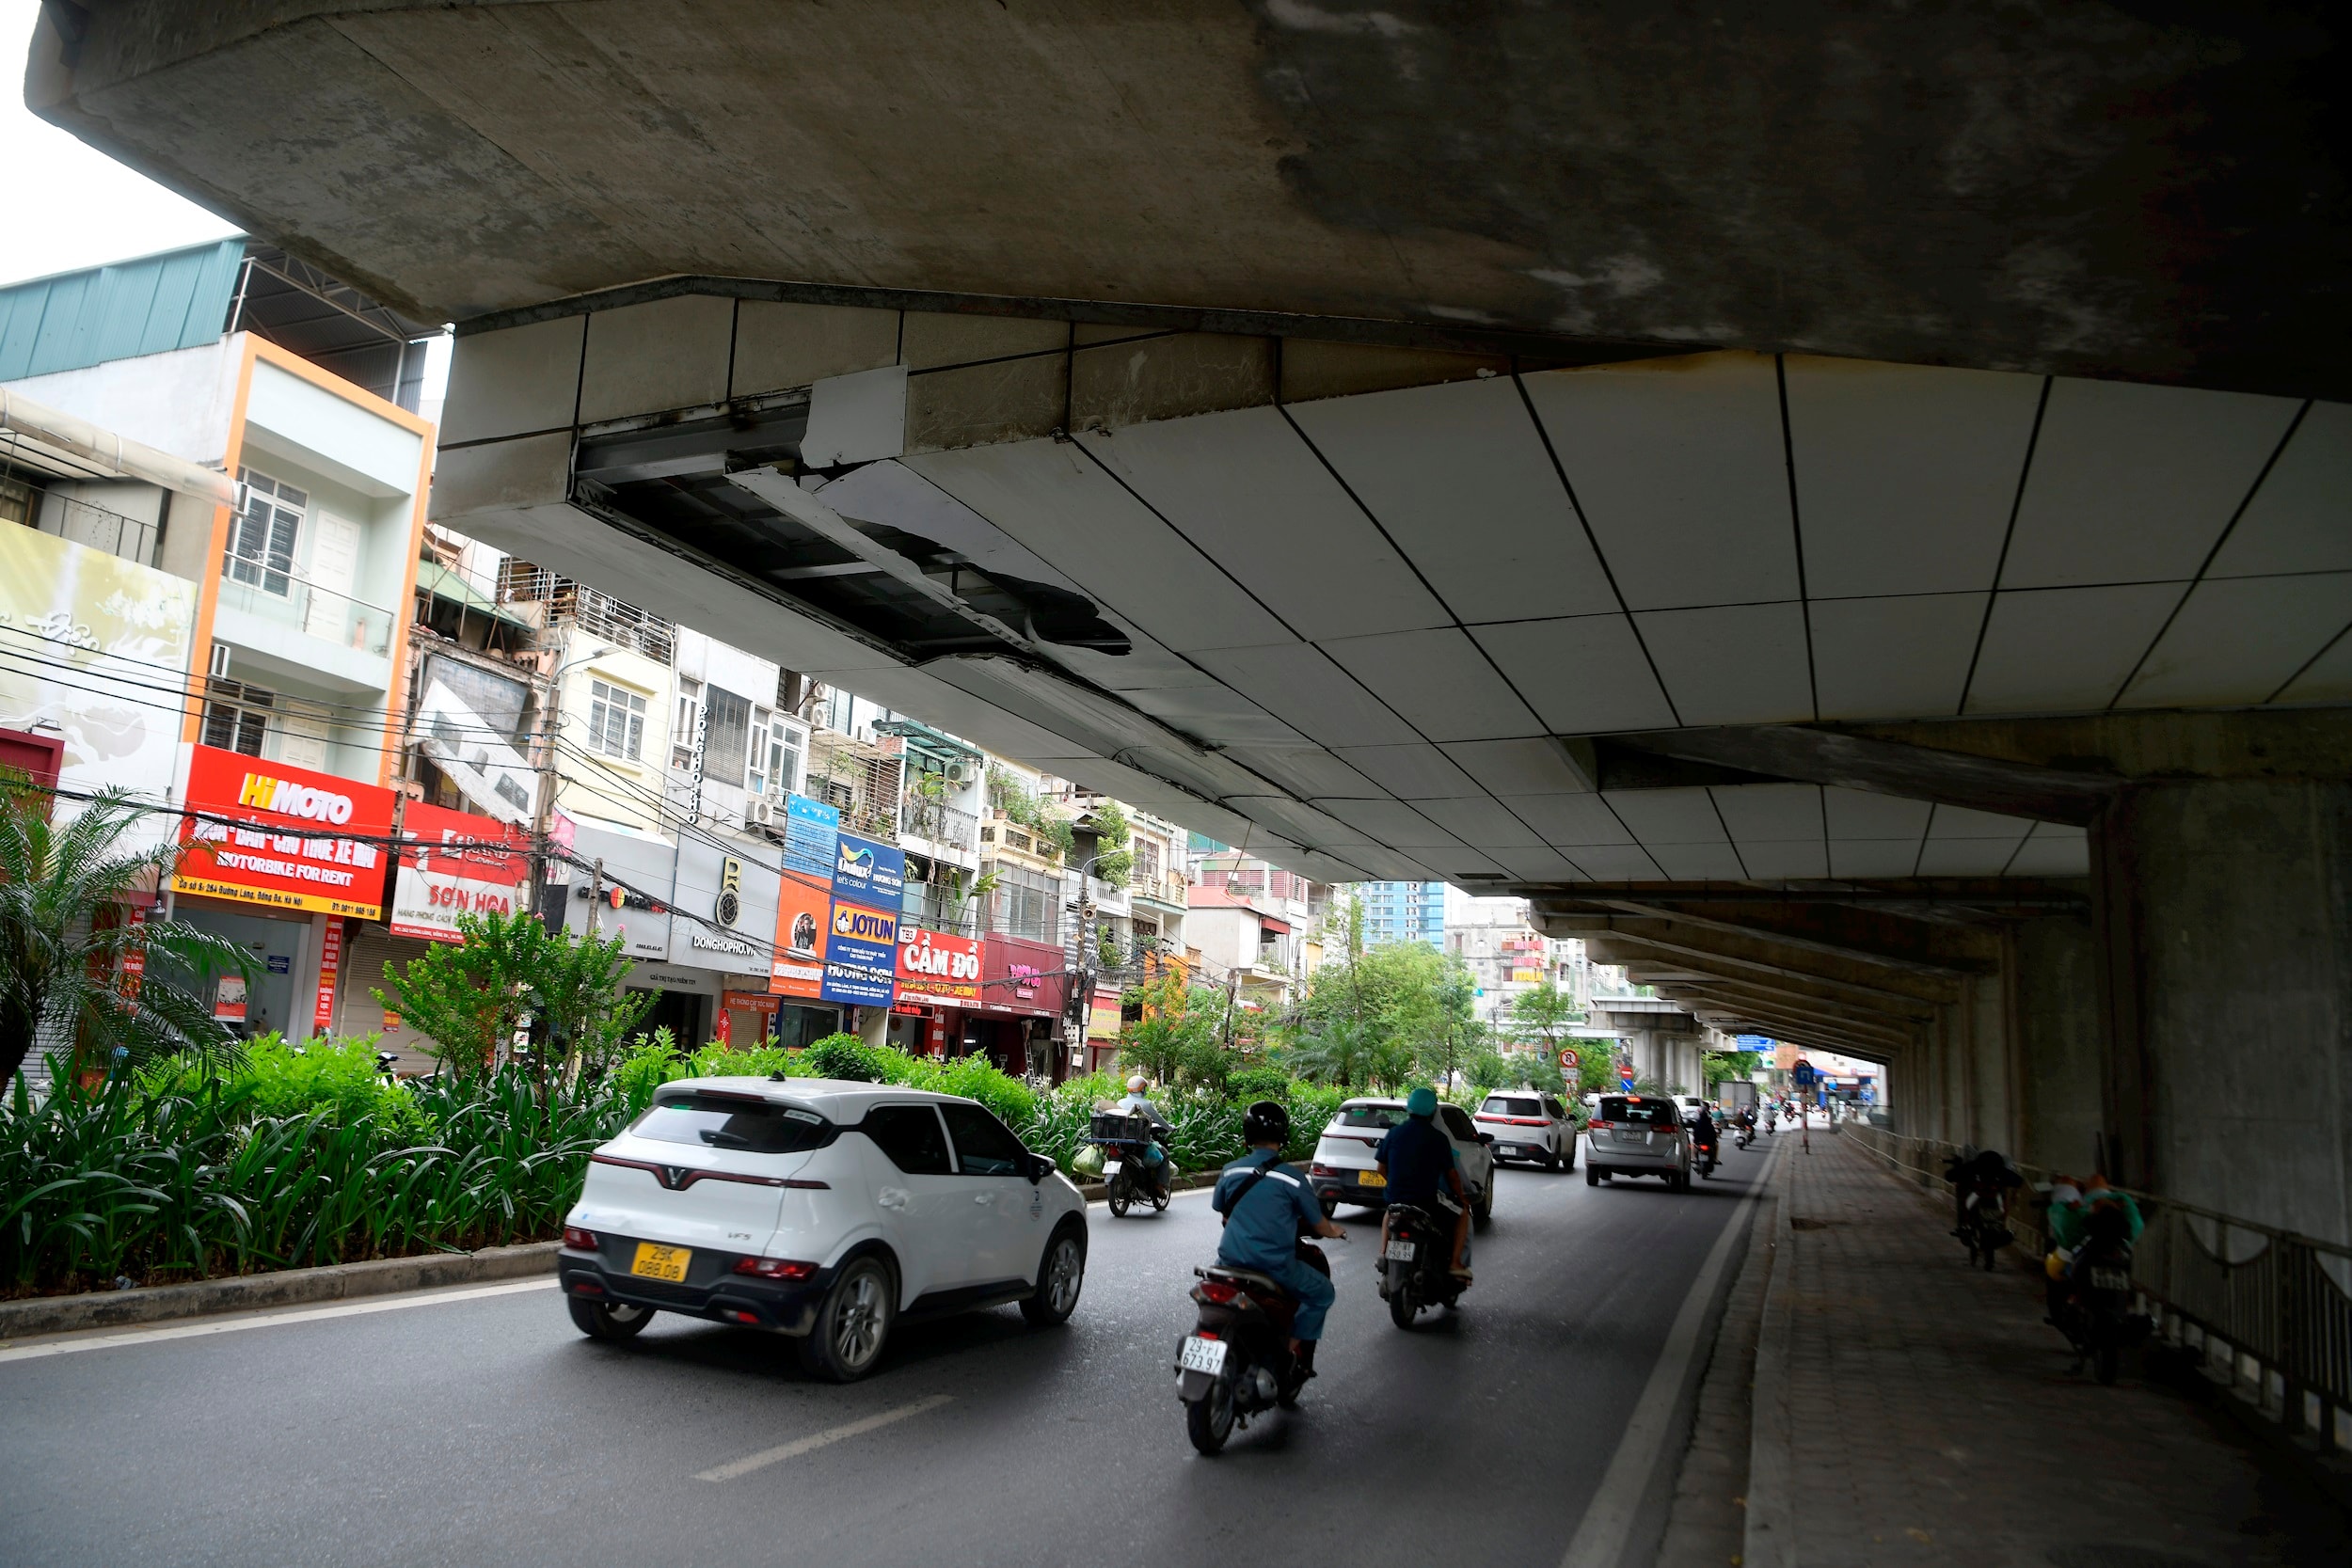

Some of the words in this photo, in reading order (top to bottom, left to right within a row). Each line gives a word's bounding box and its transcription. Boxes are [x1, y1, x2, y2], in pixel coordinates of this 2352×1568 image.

[238, 772, 353, 826] HiMOTO
[216, 850, 295, 878] MOTORBIKE
[295, 863, 321, 882] FOR
[321, 868, 355, 887] RENT
[837, 857, 872, 879] Dulux
[837, 875, 849, 886] let's
[849, 878, 866, 889] colour
[428, 884, 469, 911] SƠN
[850, 913, 894, 940] JOTUN
[903, 932, 950, 976] CẦM
[951, 942, 979, 980] ĐỒ
[650, 1246, 675, 1261] 29K
[1183, 1353, 1220, 1371] 673.97
